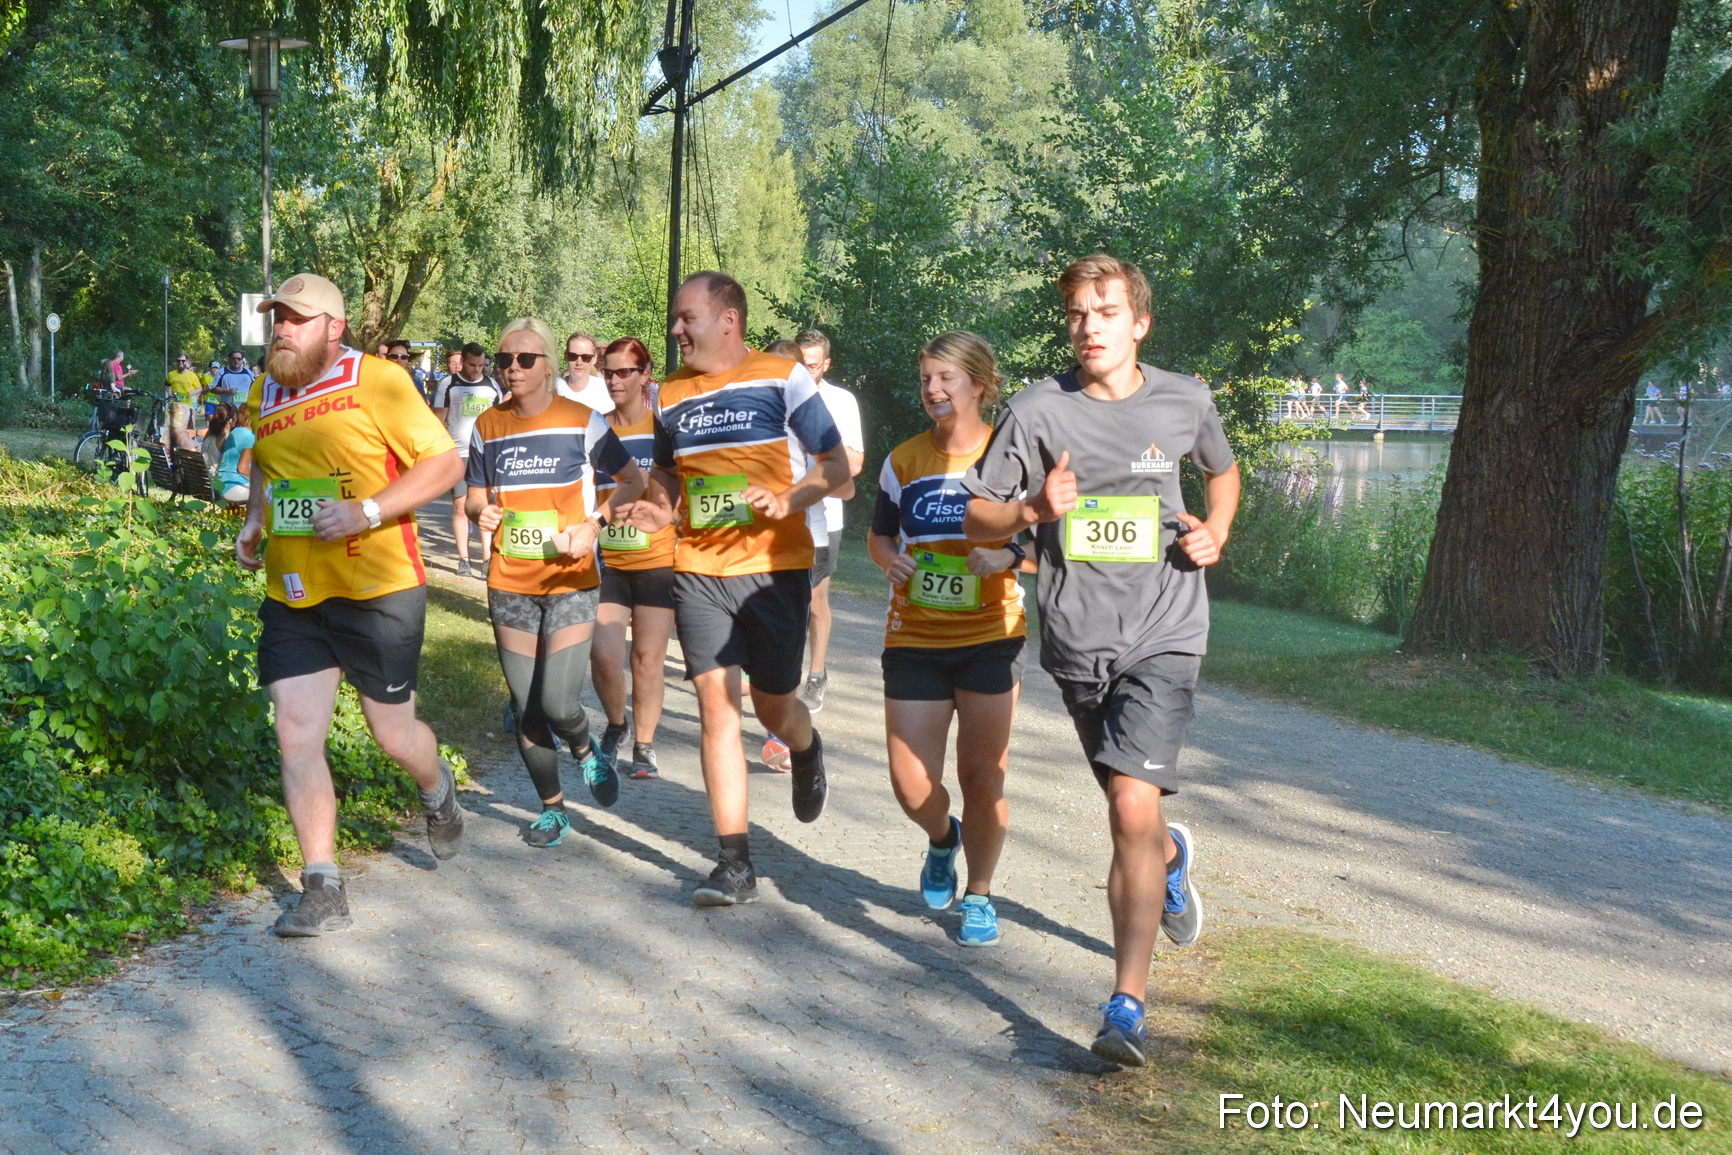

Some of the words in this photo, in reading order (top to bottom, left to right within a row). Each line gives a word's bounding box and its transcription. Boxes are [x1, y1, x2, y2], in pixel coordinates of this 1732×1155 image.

[466, 403, 486, 412] 1467
[257, 412, 297, 442] MAX
[303, 394, 361, 422] BÖGL
[689, 409, 757, 429] Fischer
[694, 422, 752, 436] AUTOMOBILE
[504, 455, 560, 470] Fischer
[1131, 461, 1174, 469] BURKHARDT
[508, 467, 556, 476] AUTOMOBILE
[277, 498, 327, 519] 128
[700, 494, 735, 513] 575
[925, 501, 966, 516] Fisc
[510, 528, 543, 546] 569
[607, 523, 637, 539] 610
[1086, 520, 1137, 543] 306
[921, 571, 963, 596] 576
